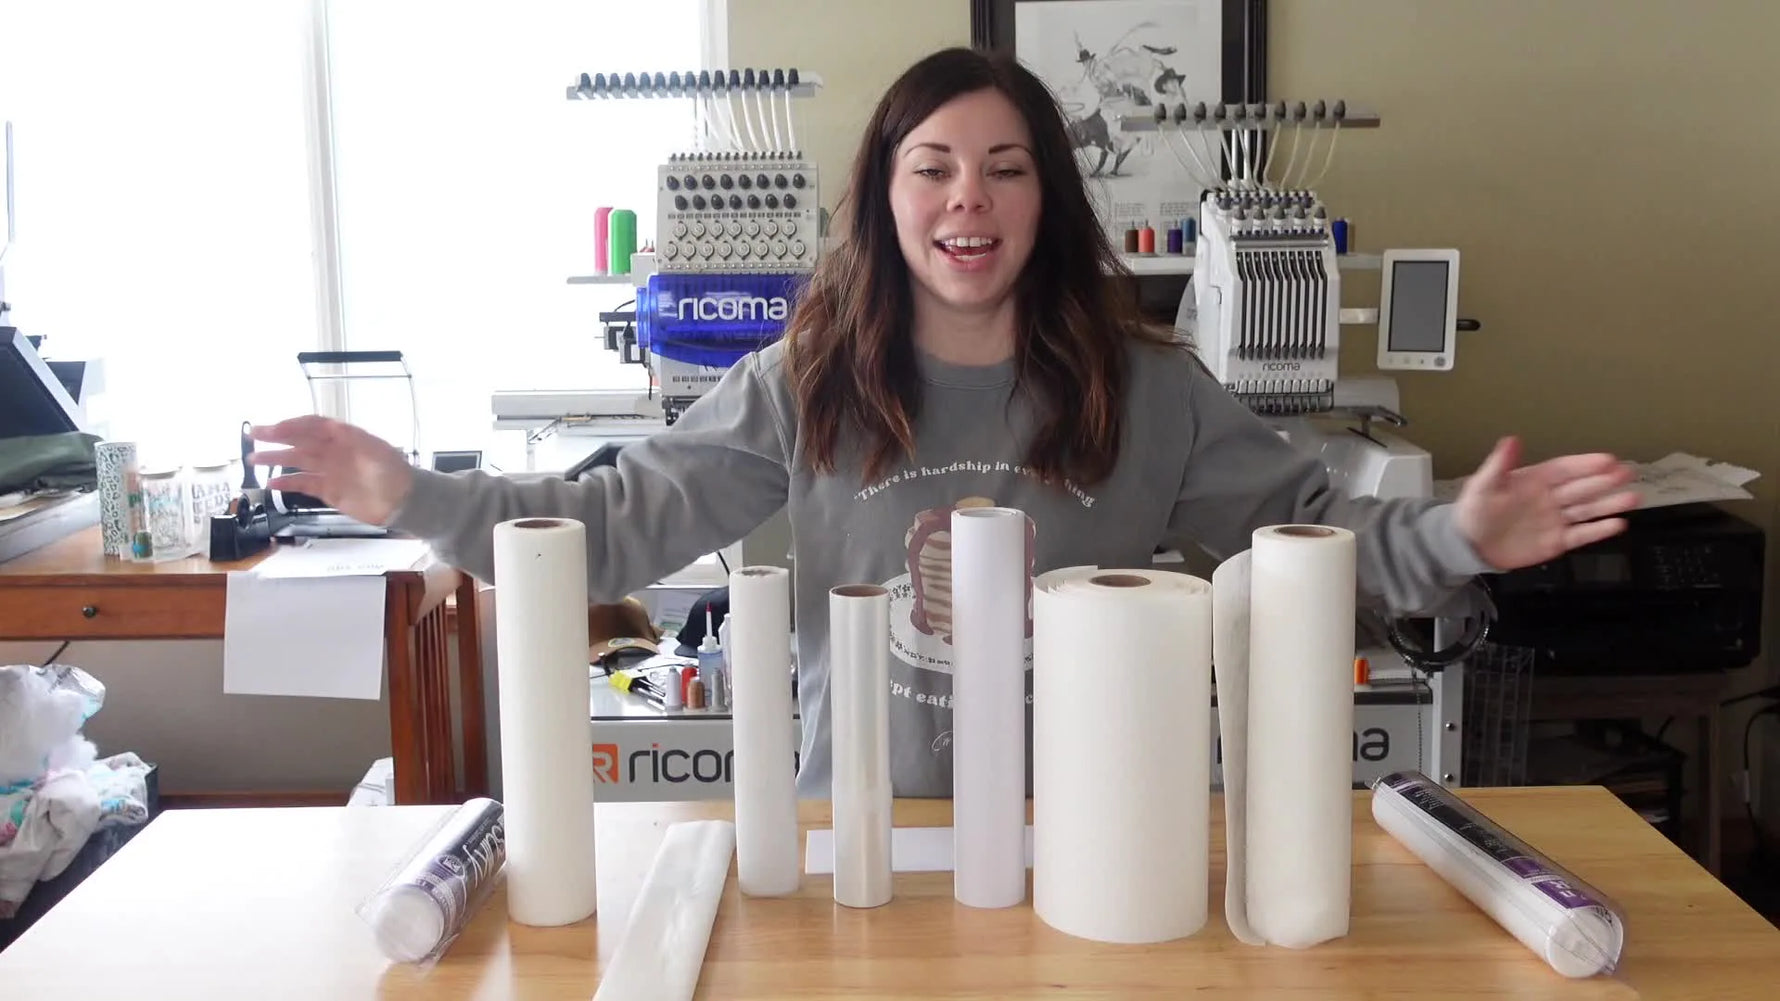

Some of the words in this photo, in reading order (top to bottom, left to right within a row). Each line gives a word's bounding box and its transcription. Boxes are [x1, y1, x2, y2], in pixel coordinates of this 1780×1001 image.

[678, 297, 788, 320] ricoma
[1262, 362, 1301, 372] ricoma
[903, 469, 918, 480] is
[921, 460, 991, 477] hardship
[995, 461, 1010, 471] in
